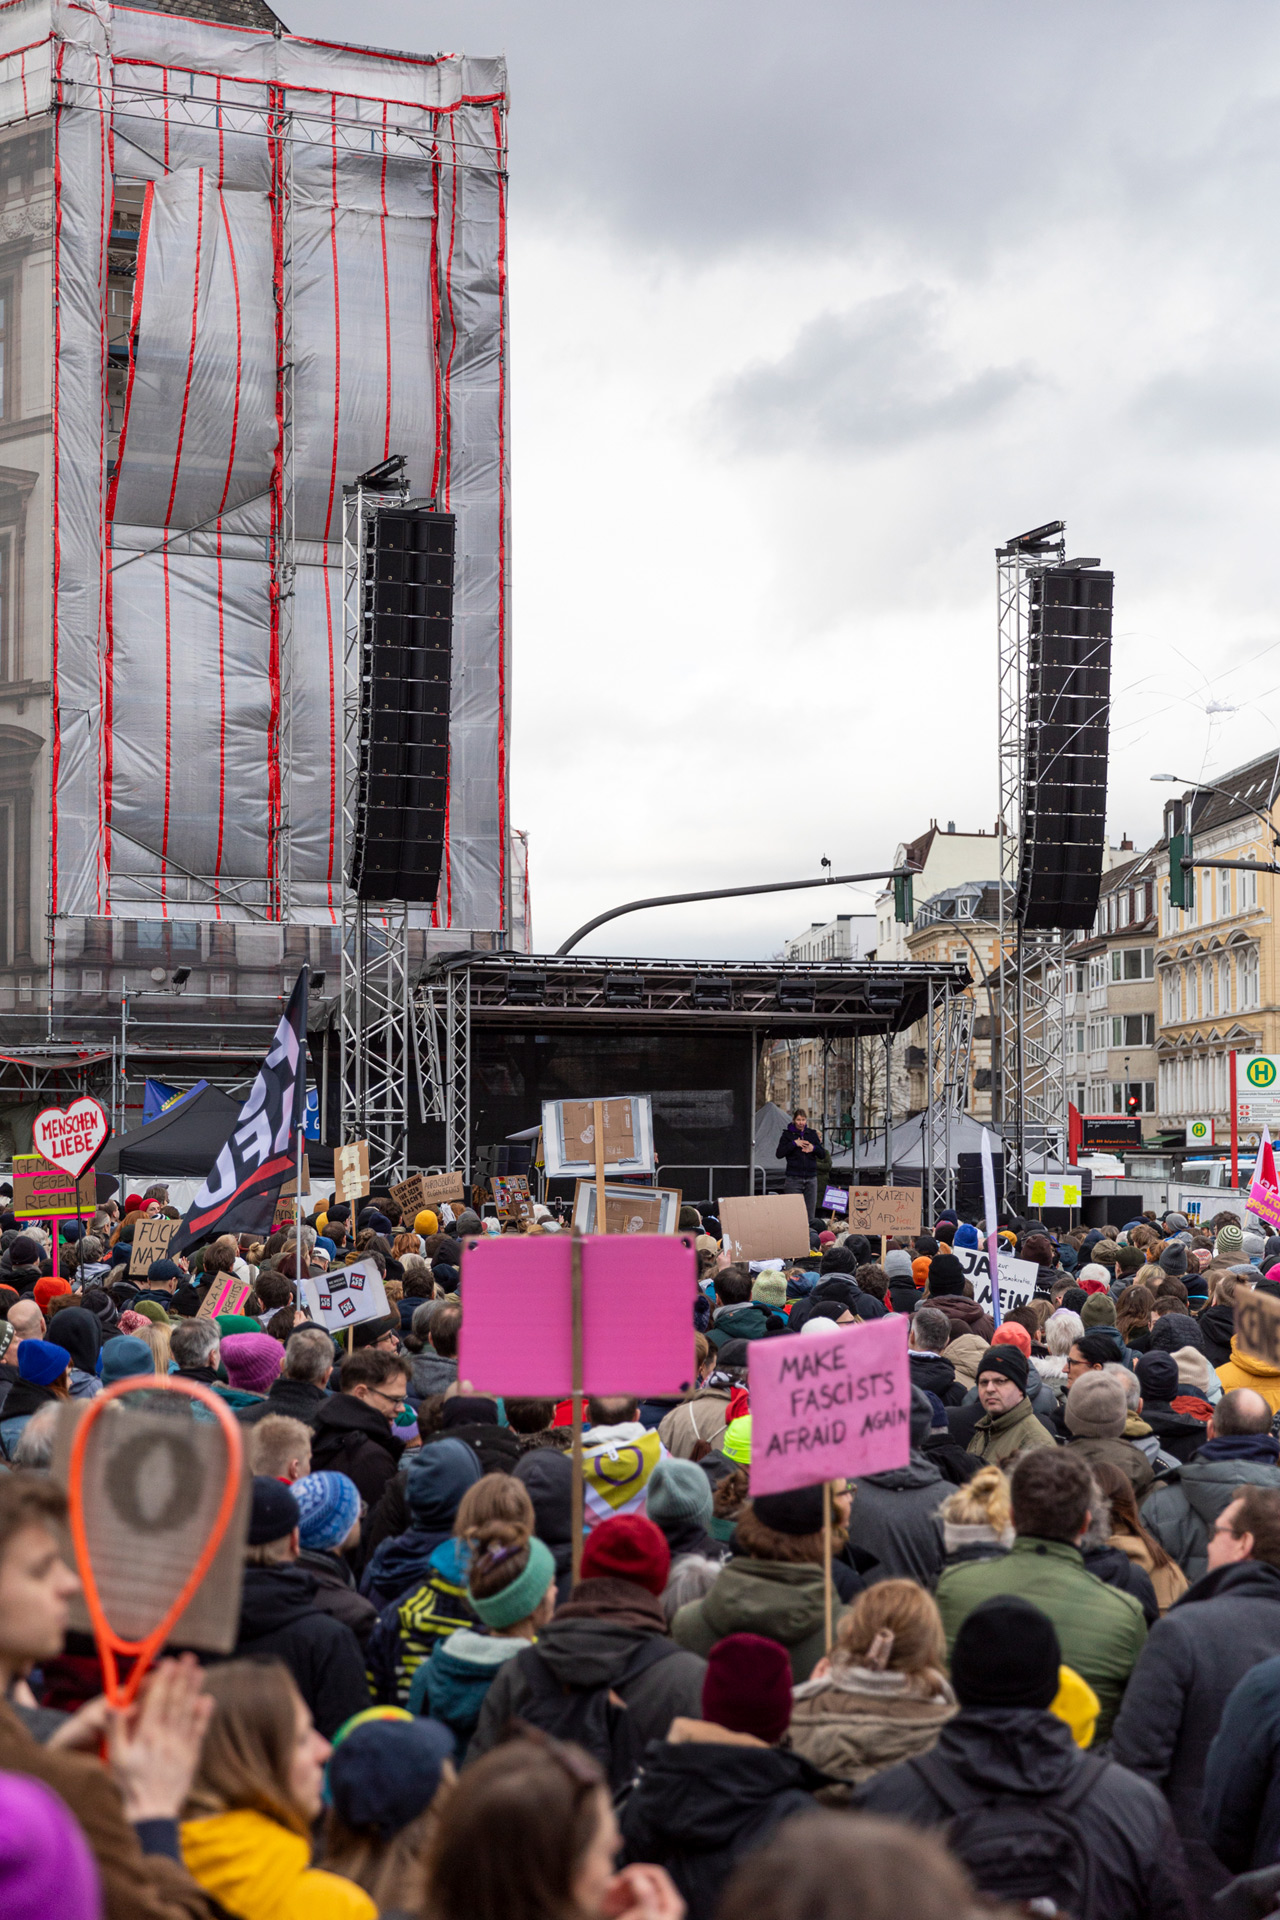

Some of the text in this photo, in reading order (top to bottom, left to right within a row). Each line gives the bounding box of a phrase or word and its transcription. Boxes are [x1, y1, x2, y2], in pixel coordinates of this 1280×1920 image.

[41, 1110, 98, 1141] MENSCHEN
[52, 1132, 94, 1159] LIEBE
[33, 1175, 76, 1190] GEGEN
[402, 1191, 423, 1207] NICHT
[415, 1201, 425, 1209] VOL
[877, 1190, 914, 1202] KATZEN
[1264, 1191, 1280, 1209] Fra
[1247, 1197, 1277, 1220] gegen
[139, 1222, 179, 1243] FUCK
[963, 1252, 991, 1280] JA
[779, 1346, 847, 1383] MAKE
